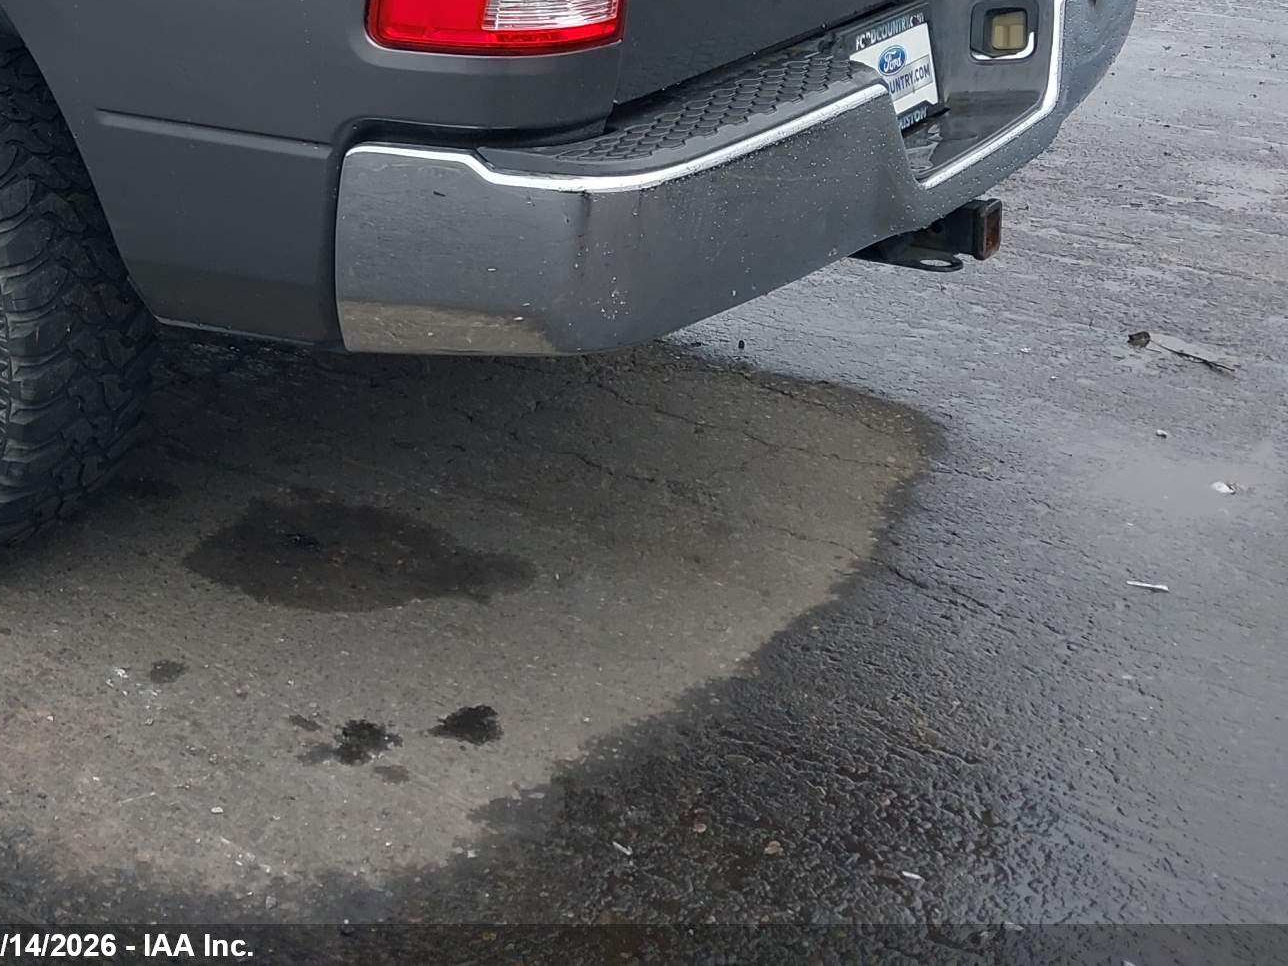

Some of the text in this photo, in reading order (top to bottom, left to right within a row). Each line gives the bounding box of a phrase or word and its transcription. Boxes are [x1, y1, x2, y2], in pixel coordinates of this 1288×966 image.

[855, 13, 925, 51] FODCOUNTRY.CM
[883, 50, 903, 73] Ford
[889, 63, 931, 95] UNTRY.COM
